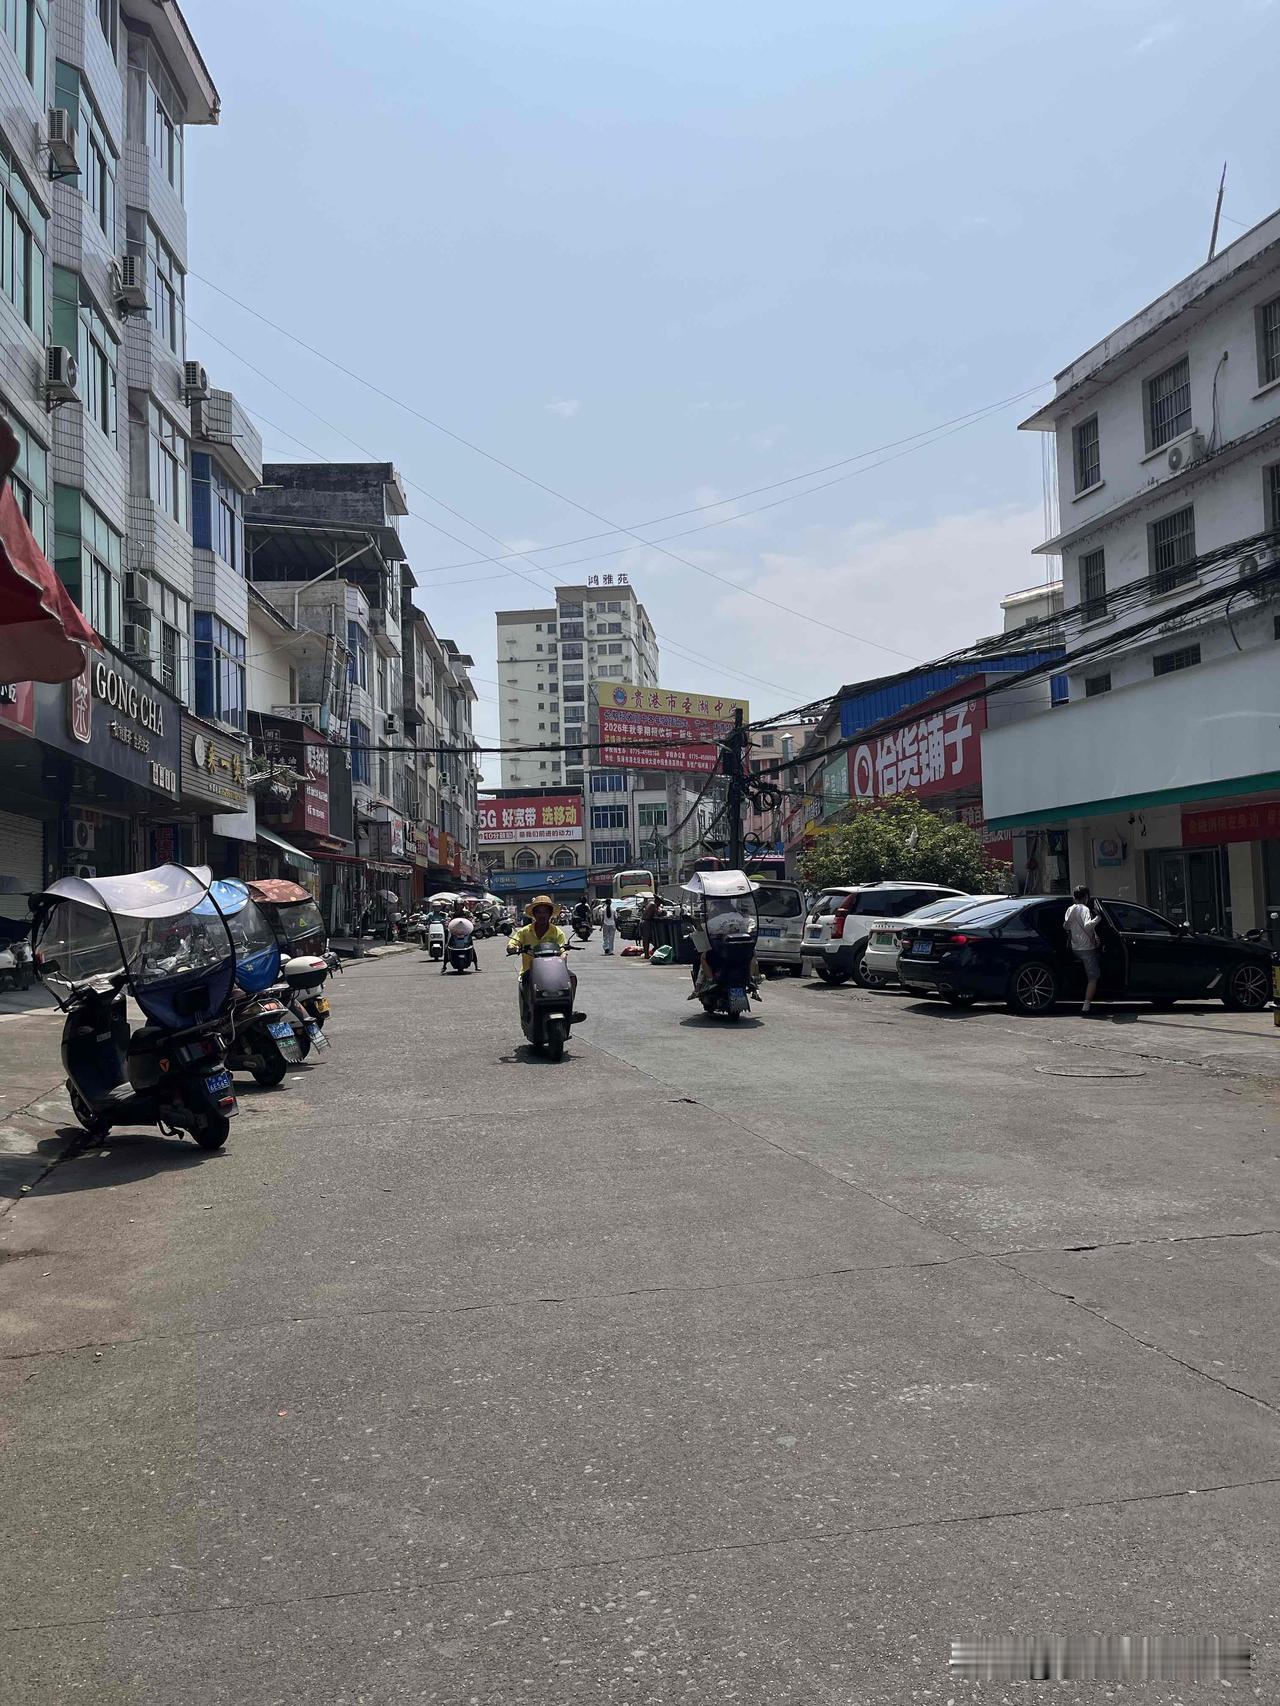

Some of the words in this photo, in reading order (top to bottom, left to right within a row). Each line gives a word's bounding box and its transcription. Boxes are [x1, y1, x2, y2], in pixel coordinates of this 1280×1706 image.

[588, 573, 629, 586] 鸿雅苑
[96, 662, 138, 719] GONG
[140, 695, 164, 737] CHA
[502, 807, 536, 828] 好宽带
[542, 805, 577, 826] 选移动
